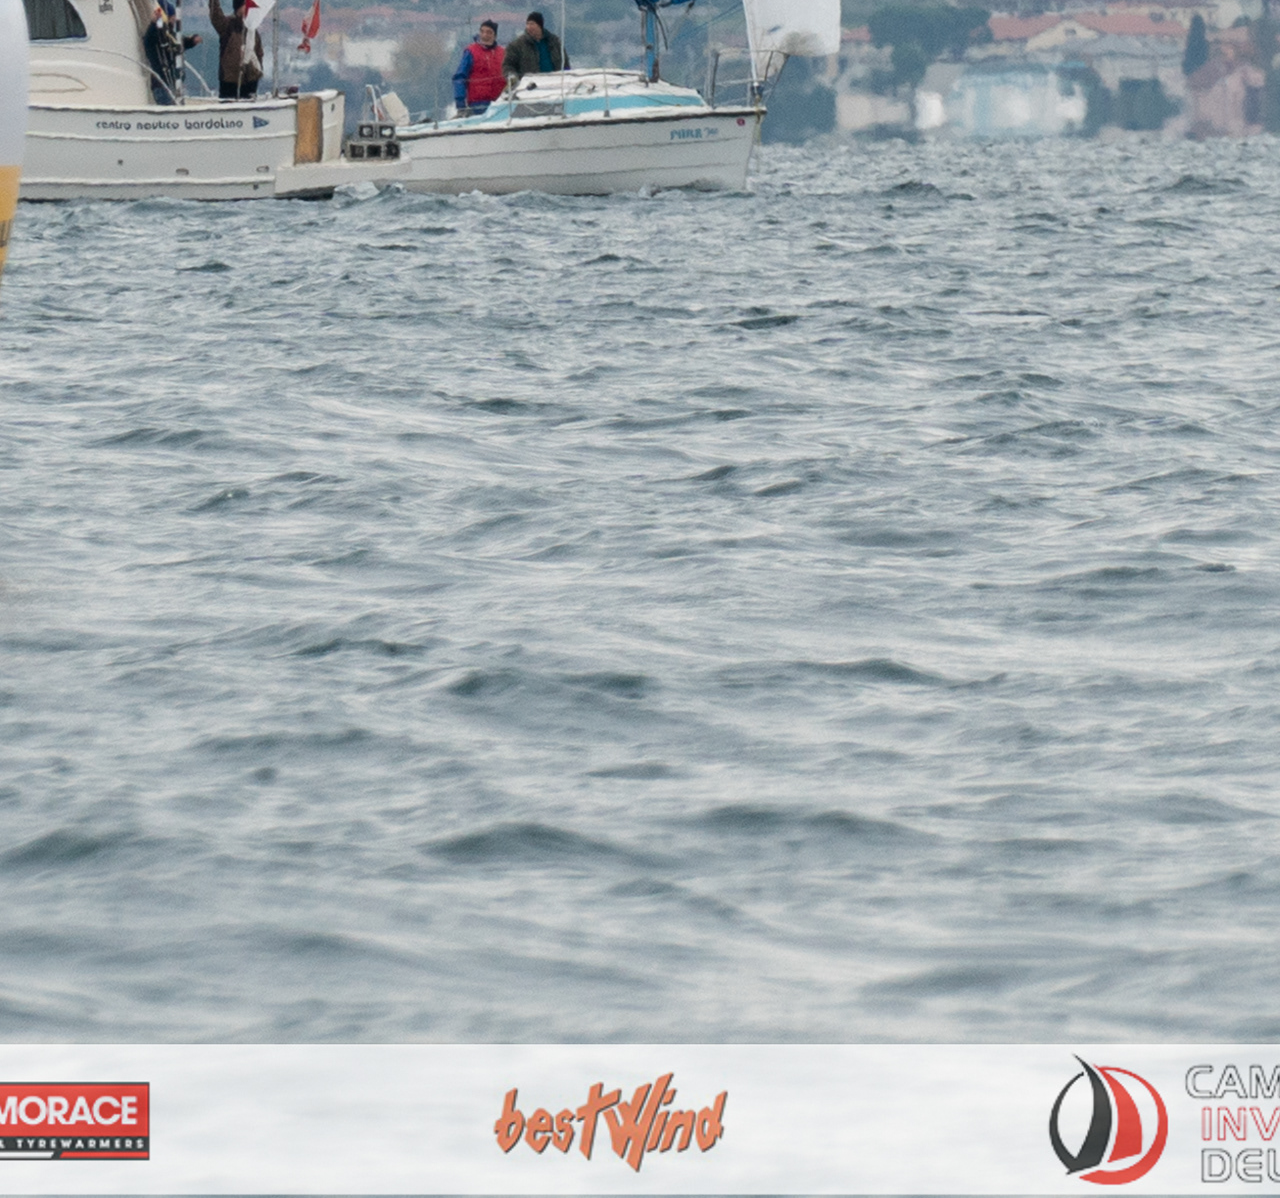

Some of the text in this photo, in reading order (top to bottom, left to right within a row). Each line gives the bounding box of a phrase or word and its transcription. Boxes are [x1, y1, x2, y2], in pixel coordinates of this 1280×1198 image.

[96, 117, 244, 131] centro nautico bardolino
